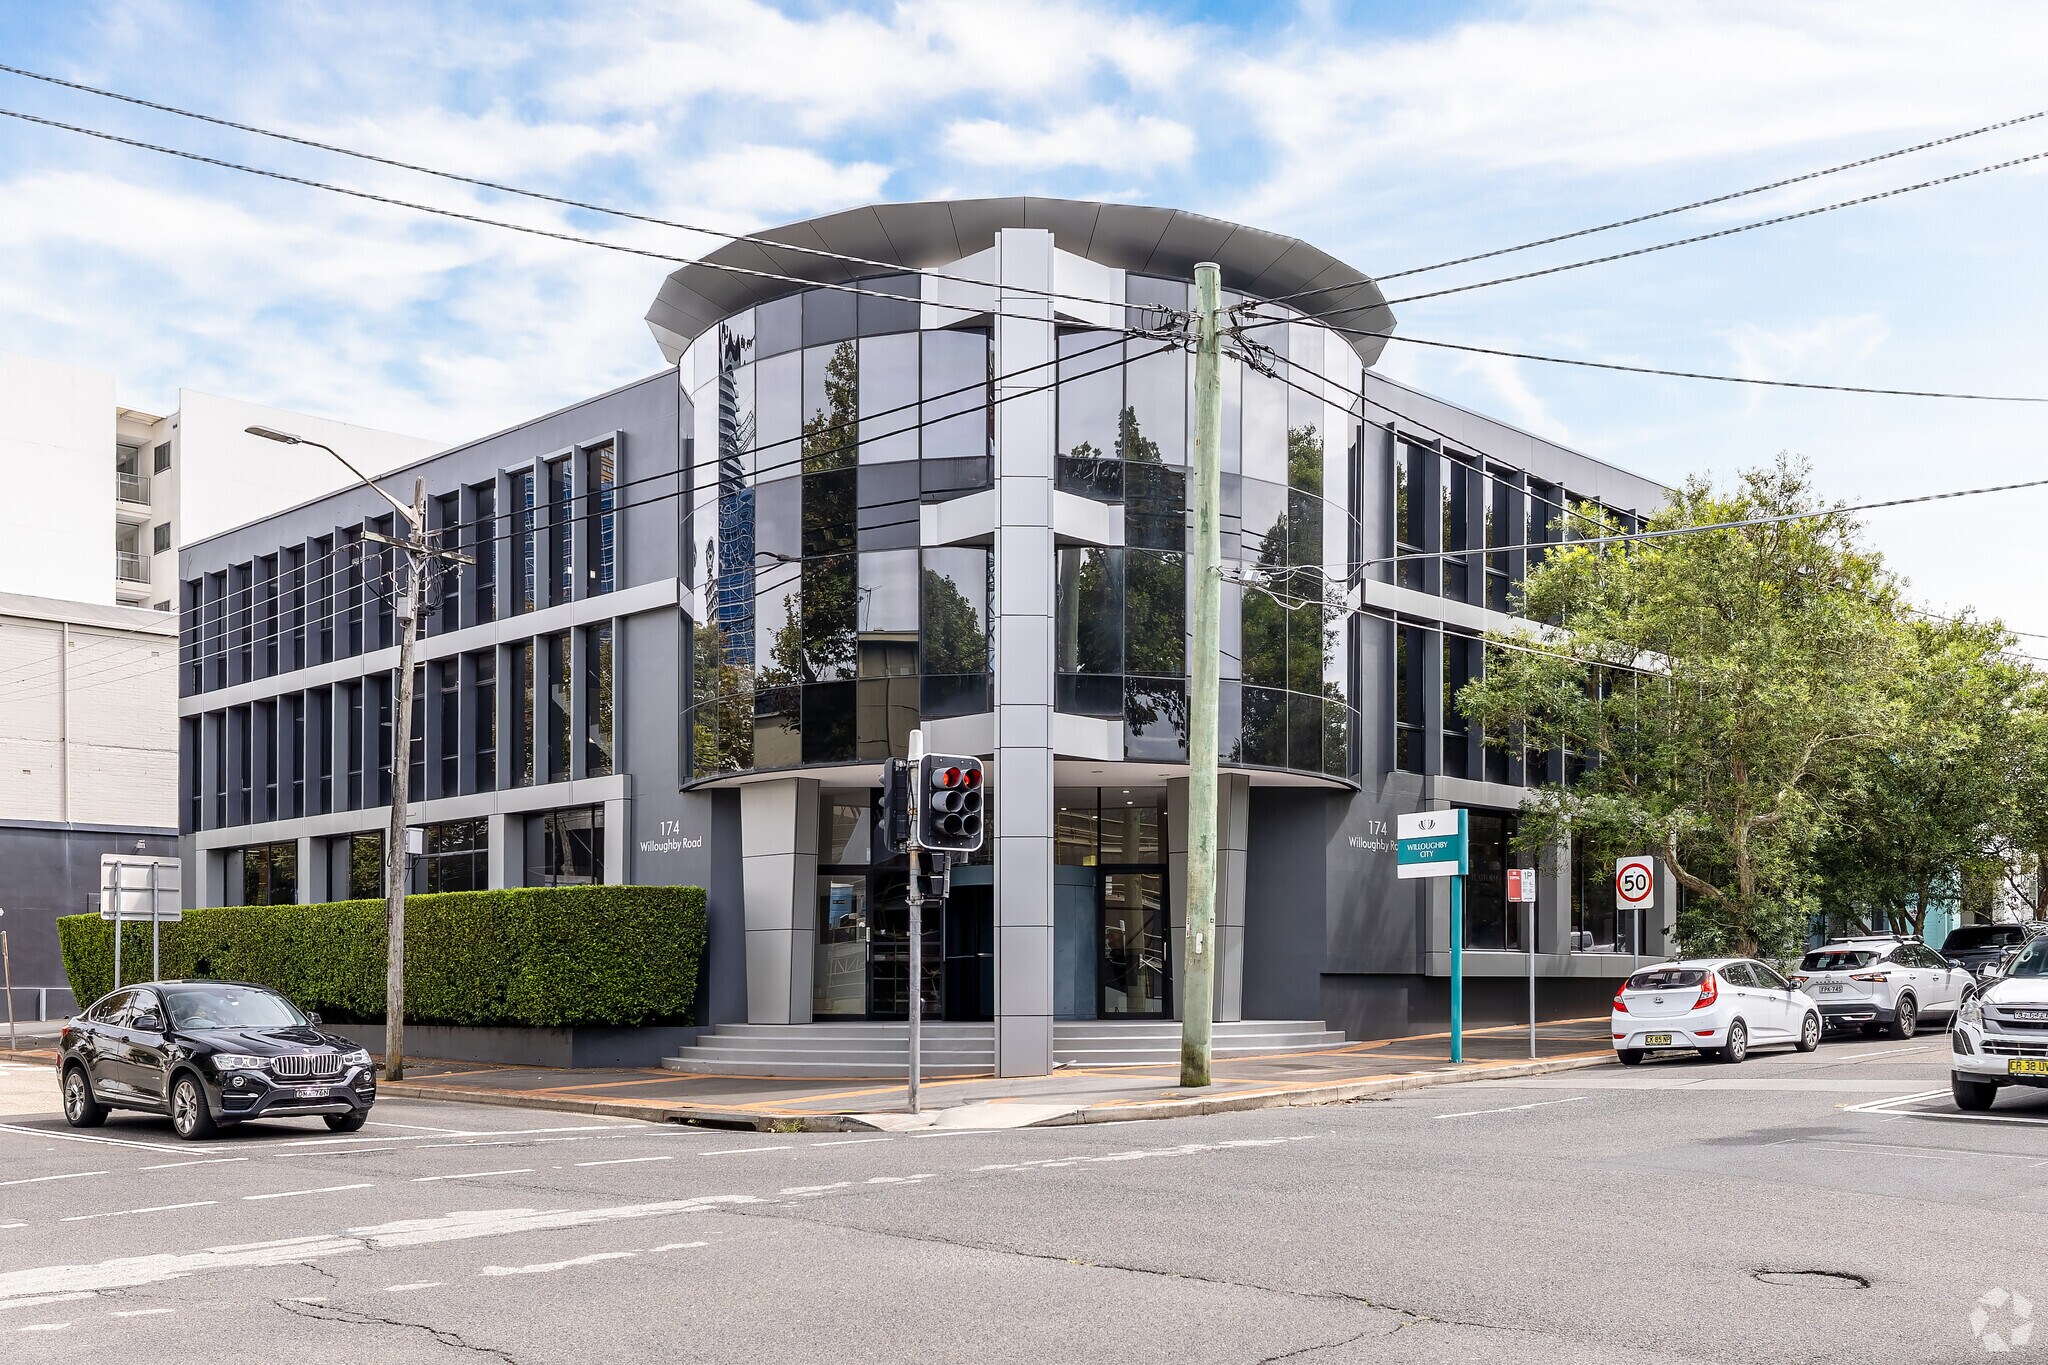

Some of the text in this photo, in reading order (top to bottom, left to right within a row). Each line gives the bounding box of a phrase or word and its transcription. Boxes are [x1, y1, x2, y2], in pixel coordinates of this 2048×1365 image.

[660, 820, 680, 836] 174
[1368, 820, 1388, 836] 174
[640, 835, 702, 853] Willoughby Road
[1348, 836, 1398, 853] Willoughby Ro
[1407, 841, 1448, 851] WILLOUGHBY
[1419, 850, 1434, 858] CITY
[1523, 870, 1533, 880] 1P
[1624, 874, 1646, 892] 50
